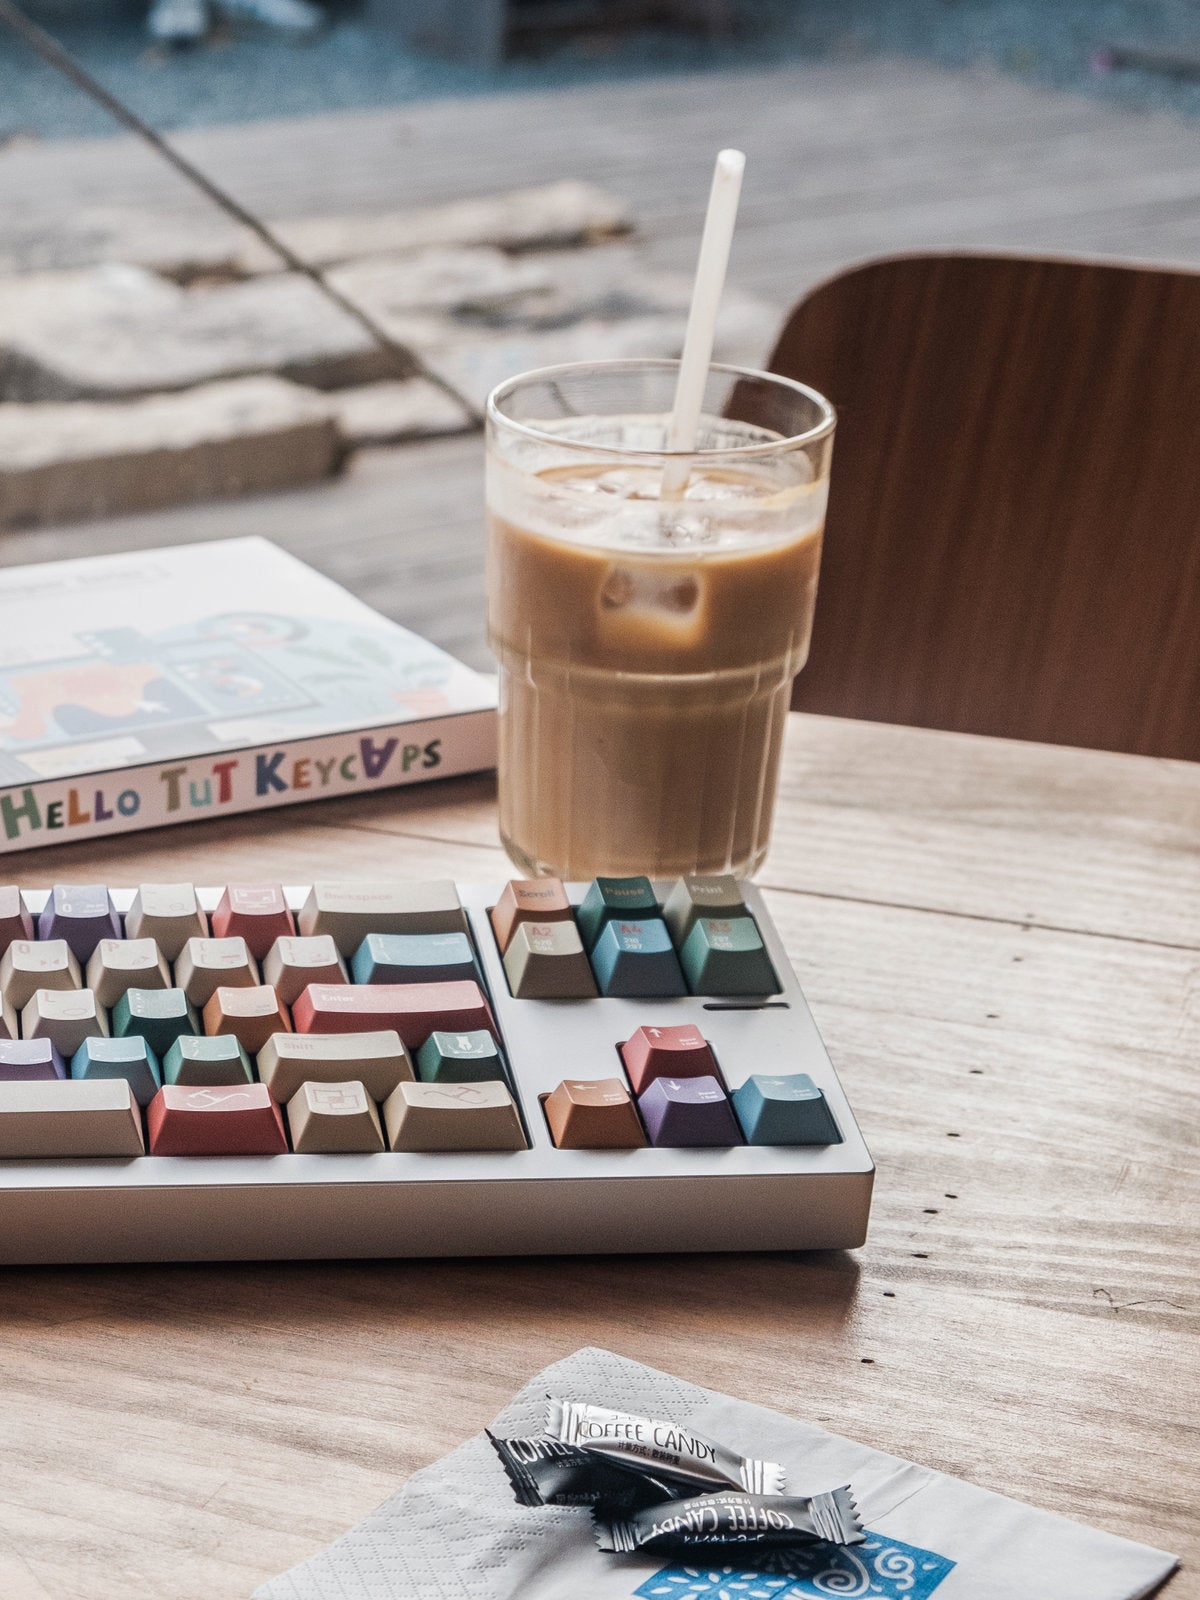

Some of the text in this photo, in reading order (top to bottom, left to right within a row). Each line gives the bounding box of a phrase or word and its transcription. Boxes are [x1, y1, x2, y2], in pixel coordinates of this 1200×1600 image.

[0, 787, 141, 840] HELLO
[255, 737, 441, 796] KEYCAPS
[518, 888, 556, 900] Scroll
[319, 994, 355, 1002] Enter
[283, 1041, 315, 1052] Shift
[579, 1421, 643, 1443] COFFEE
[653, 1427, 716, 1463] CANDY
[652, 1505, 795, 1537] COFFEE CANDY
